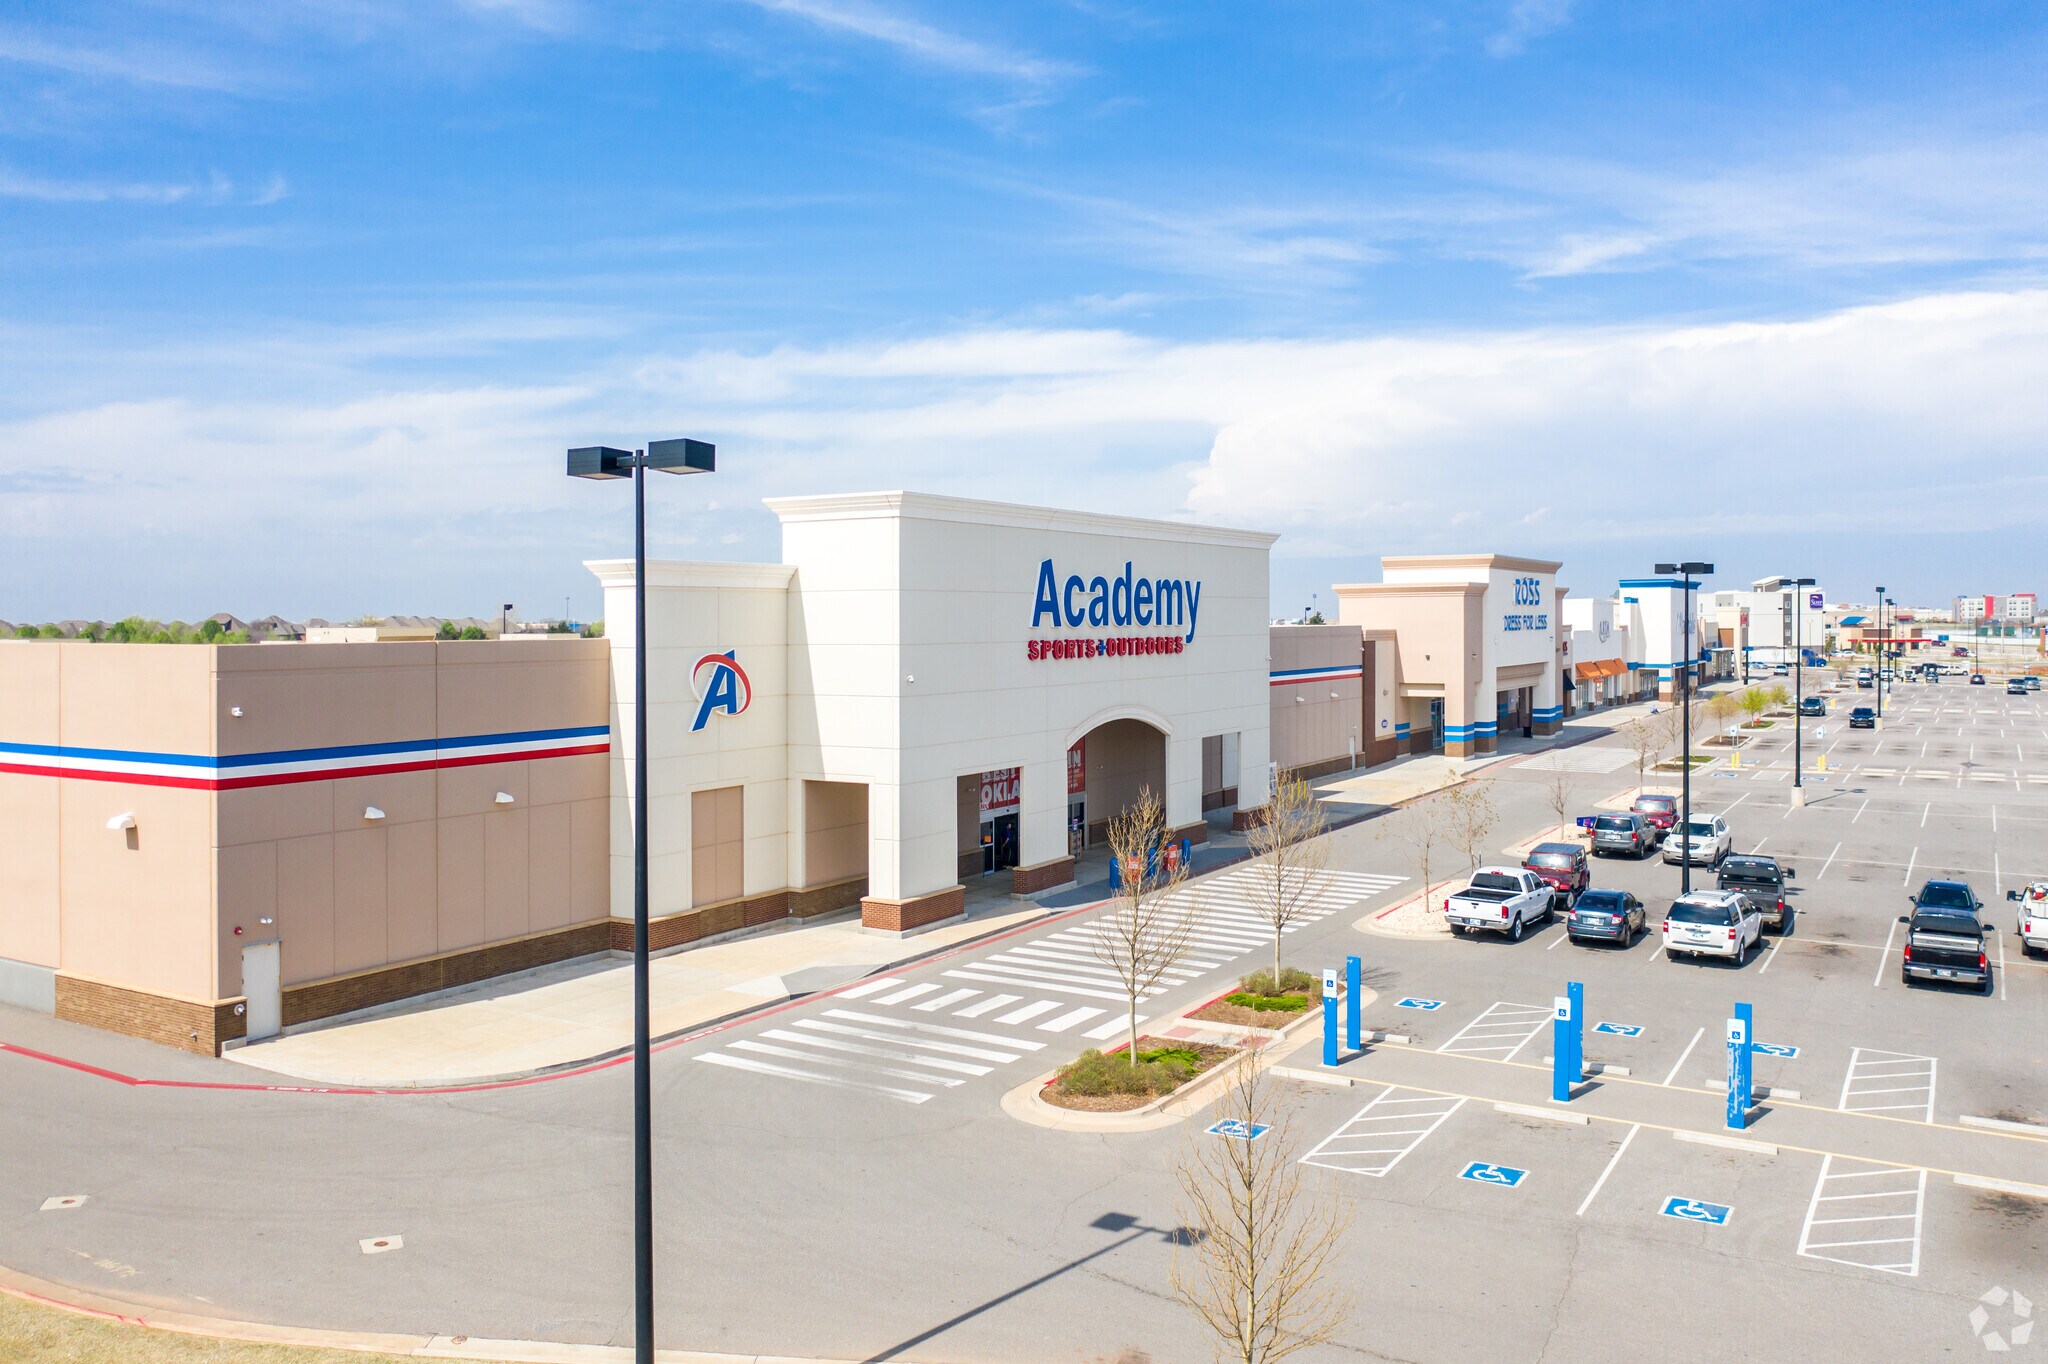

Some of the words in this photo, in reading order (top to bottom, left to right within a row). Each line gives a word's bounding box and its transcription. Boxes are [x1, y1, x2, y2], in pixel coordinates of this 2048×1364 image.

[1030, 558, 1201, 643] Academy
[1514, 578, 1540, 606] ROSS
[689, 648, 738, 732] A
